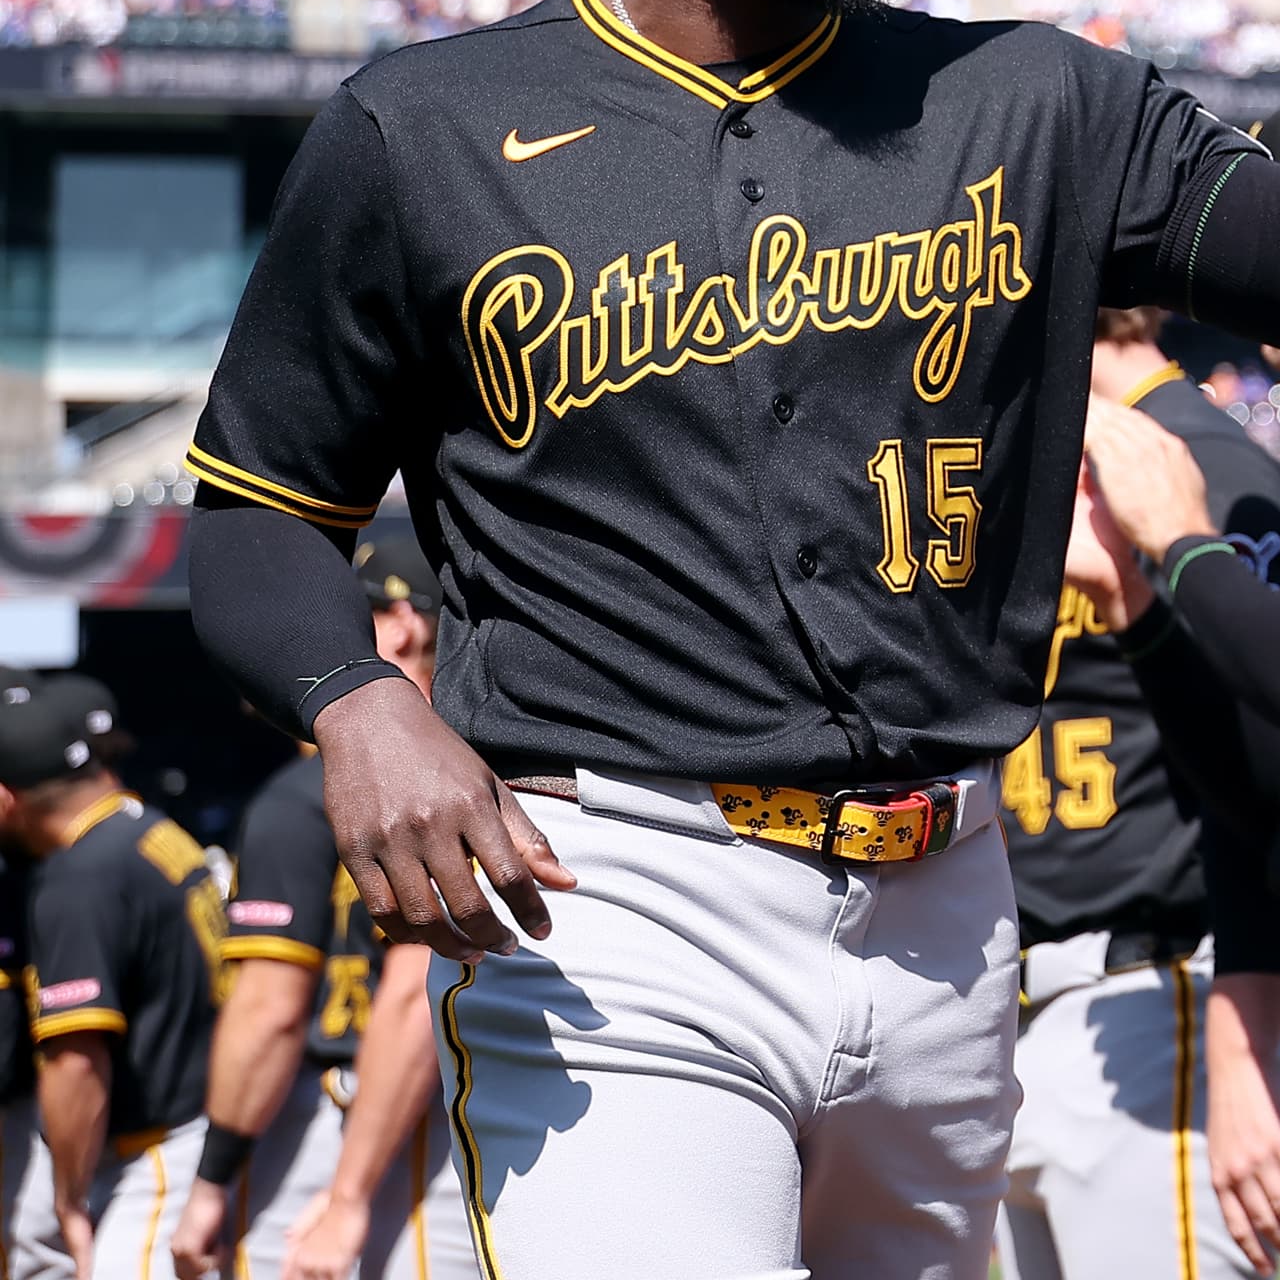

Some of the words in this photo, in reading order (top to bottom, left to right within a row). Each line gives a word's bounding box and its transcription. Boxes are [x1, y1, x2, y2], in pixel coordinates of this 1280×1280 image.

[461, 166, 1032, 448] Pittsburgh
[866, 437, 983, 594] 15
[1001, 716, 1119, 836] 45
